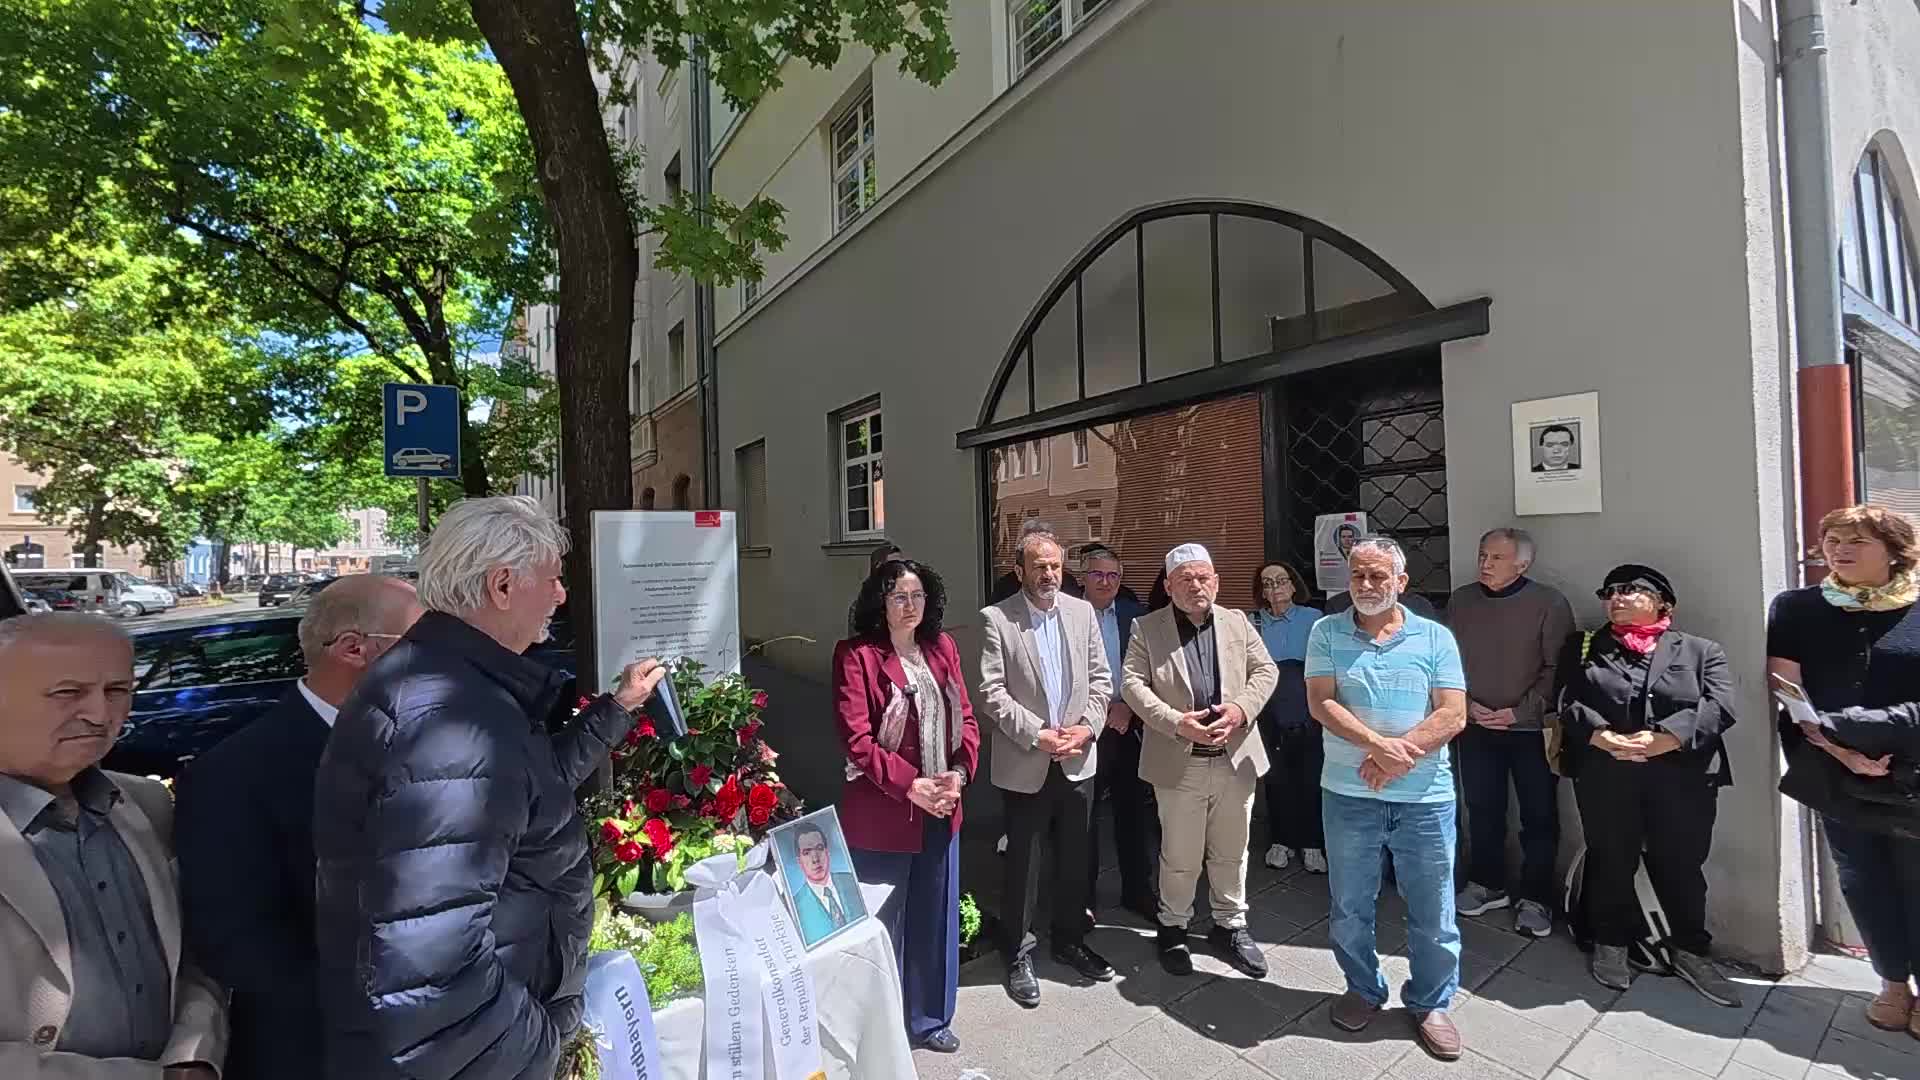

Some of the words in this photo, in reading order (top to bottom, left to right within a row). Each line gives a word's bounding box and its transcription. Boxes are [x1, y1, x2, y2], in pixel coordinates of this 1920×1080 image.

[396, 390, 428, 426] P
[725, 947, 742, 1018] Gedenken
[755, 937, 792, 1047] Generalkonsulat
[790, 963, 810, 1024] Republik
[728, 1020, 743, 1065] stillem
[800, 1026, 812, 1046] der
